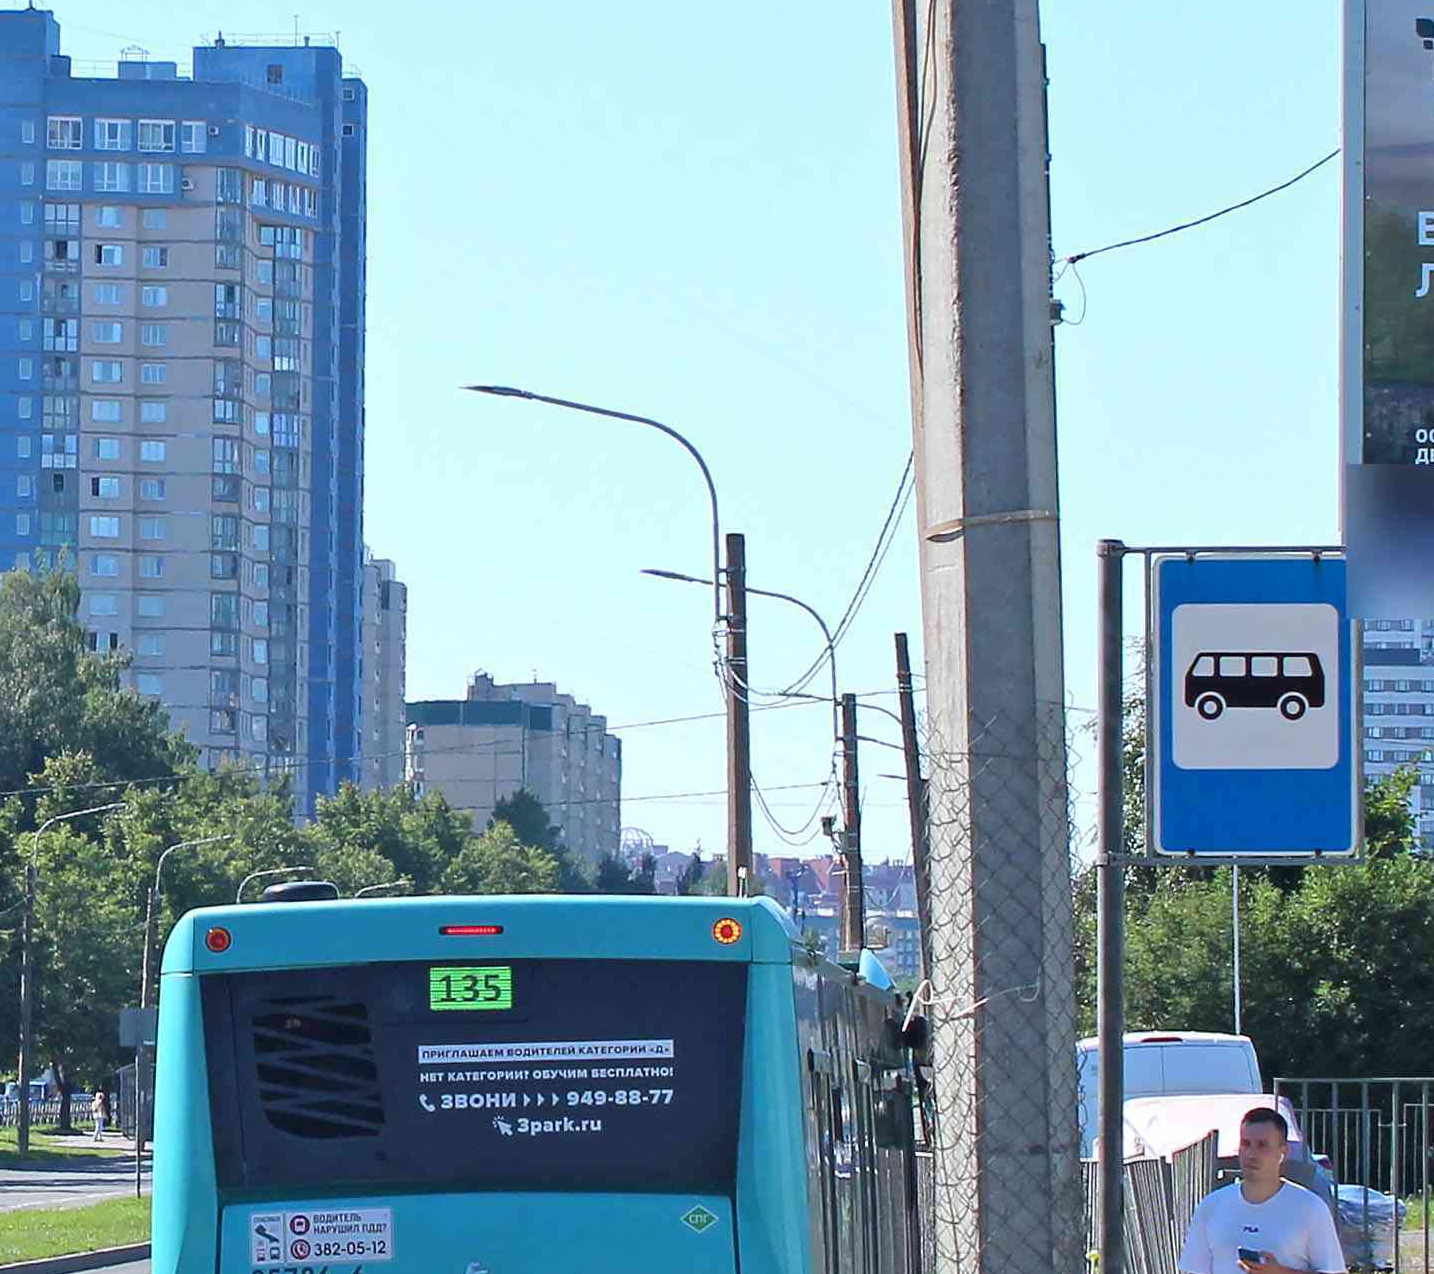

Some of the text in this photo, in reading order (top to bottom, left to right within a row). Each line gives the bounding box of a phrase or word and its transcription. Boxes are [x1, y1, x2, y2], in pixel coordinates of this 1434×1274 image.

[437, 974, 502, 1002] 135
[422, 1047, 504, 1059] ПРИГЛАШАЕМ
[507, 1045, 576, 1058] ВОДИТЕЛЕЙ
[579, 1045, 646, 1055] КАТЕГОРИИ
[420, 1067, 673, 1082] НЕТ КАТЕГОРИИ? ОБУЧИМ БЕСПЛАТНО!
[441, 1089, 673, 1109] ЗВОНИ 949-88-77
[517, 1117, 602, 1136] 3park.ru
[313, 1213, 362, 1223] ВОДИТЕЛЬ
[688, 1213, 709, 1224] СПГ
[313, 1223, 387, 1234] НАРУШИЛ ПДД?
[314, 1240, 386, 1256] 382-05-12
